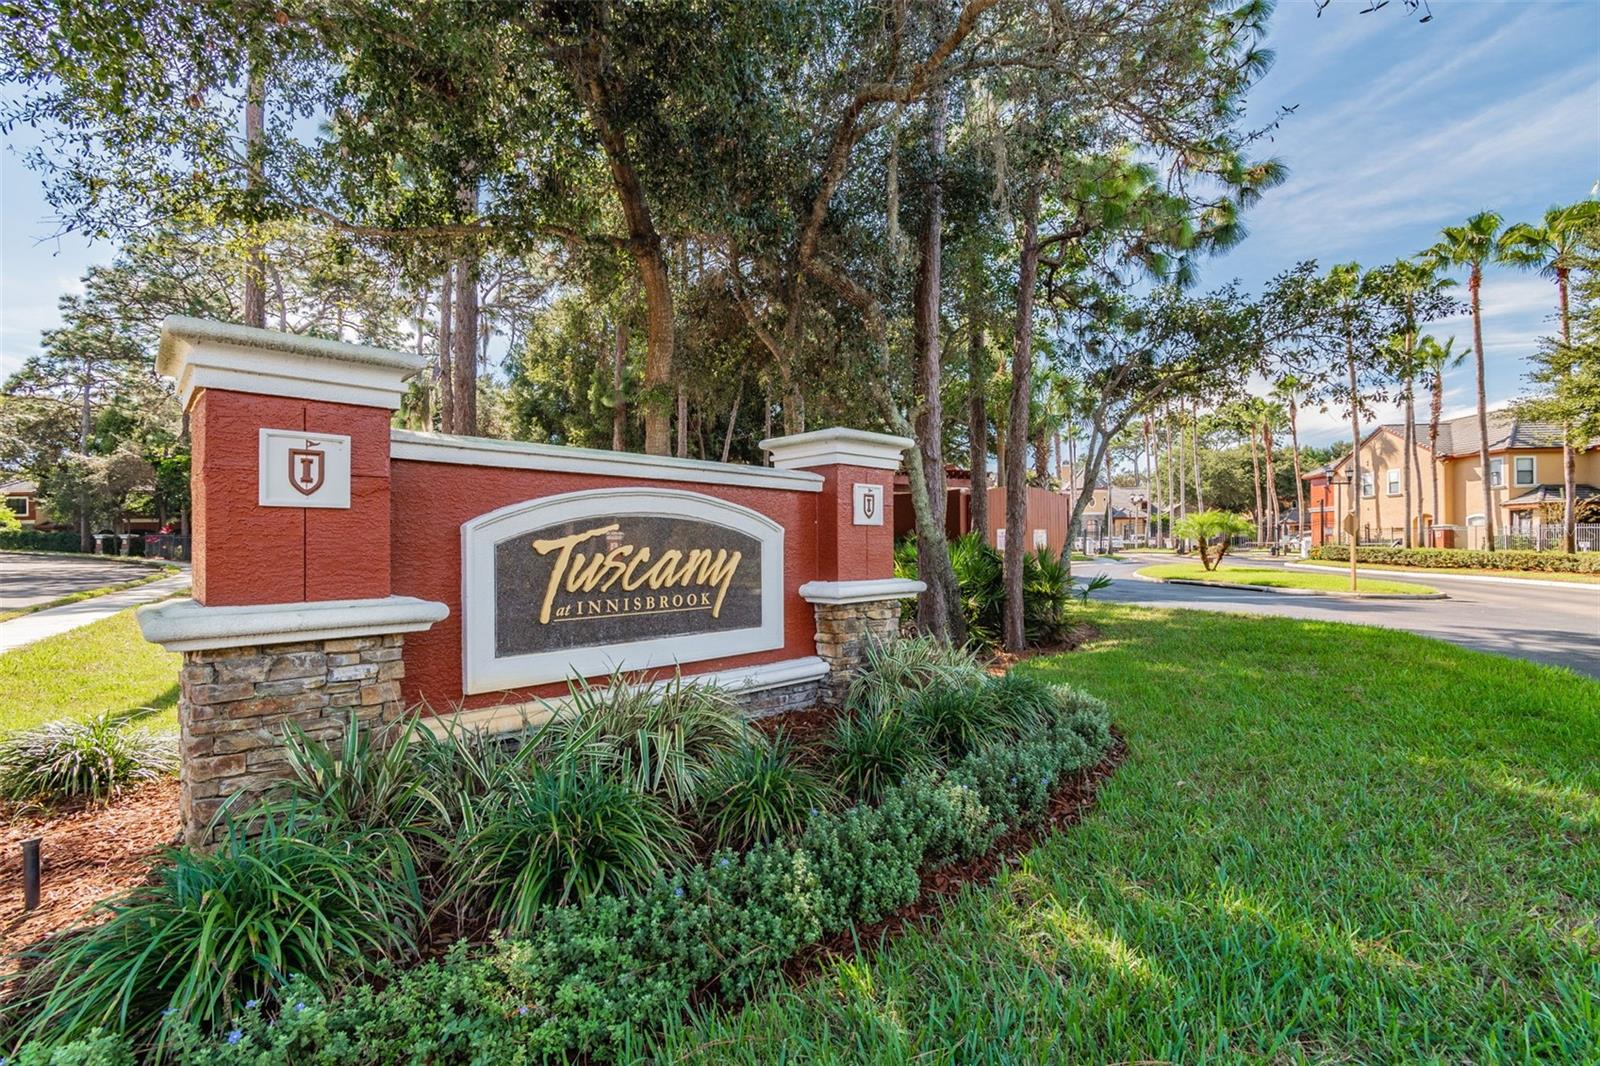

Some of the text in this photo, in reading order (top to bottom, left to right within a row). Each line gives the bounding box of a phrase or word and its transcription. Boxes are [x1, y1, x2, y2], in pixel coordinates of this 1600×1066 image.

[532, 523, 742, 624] Tuscany
[556, 592, 711, 617] at INNISBROOK
